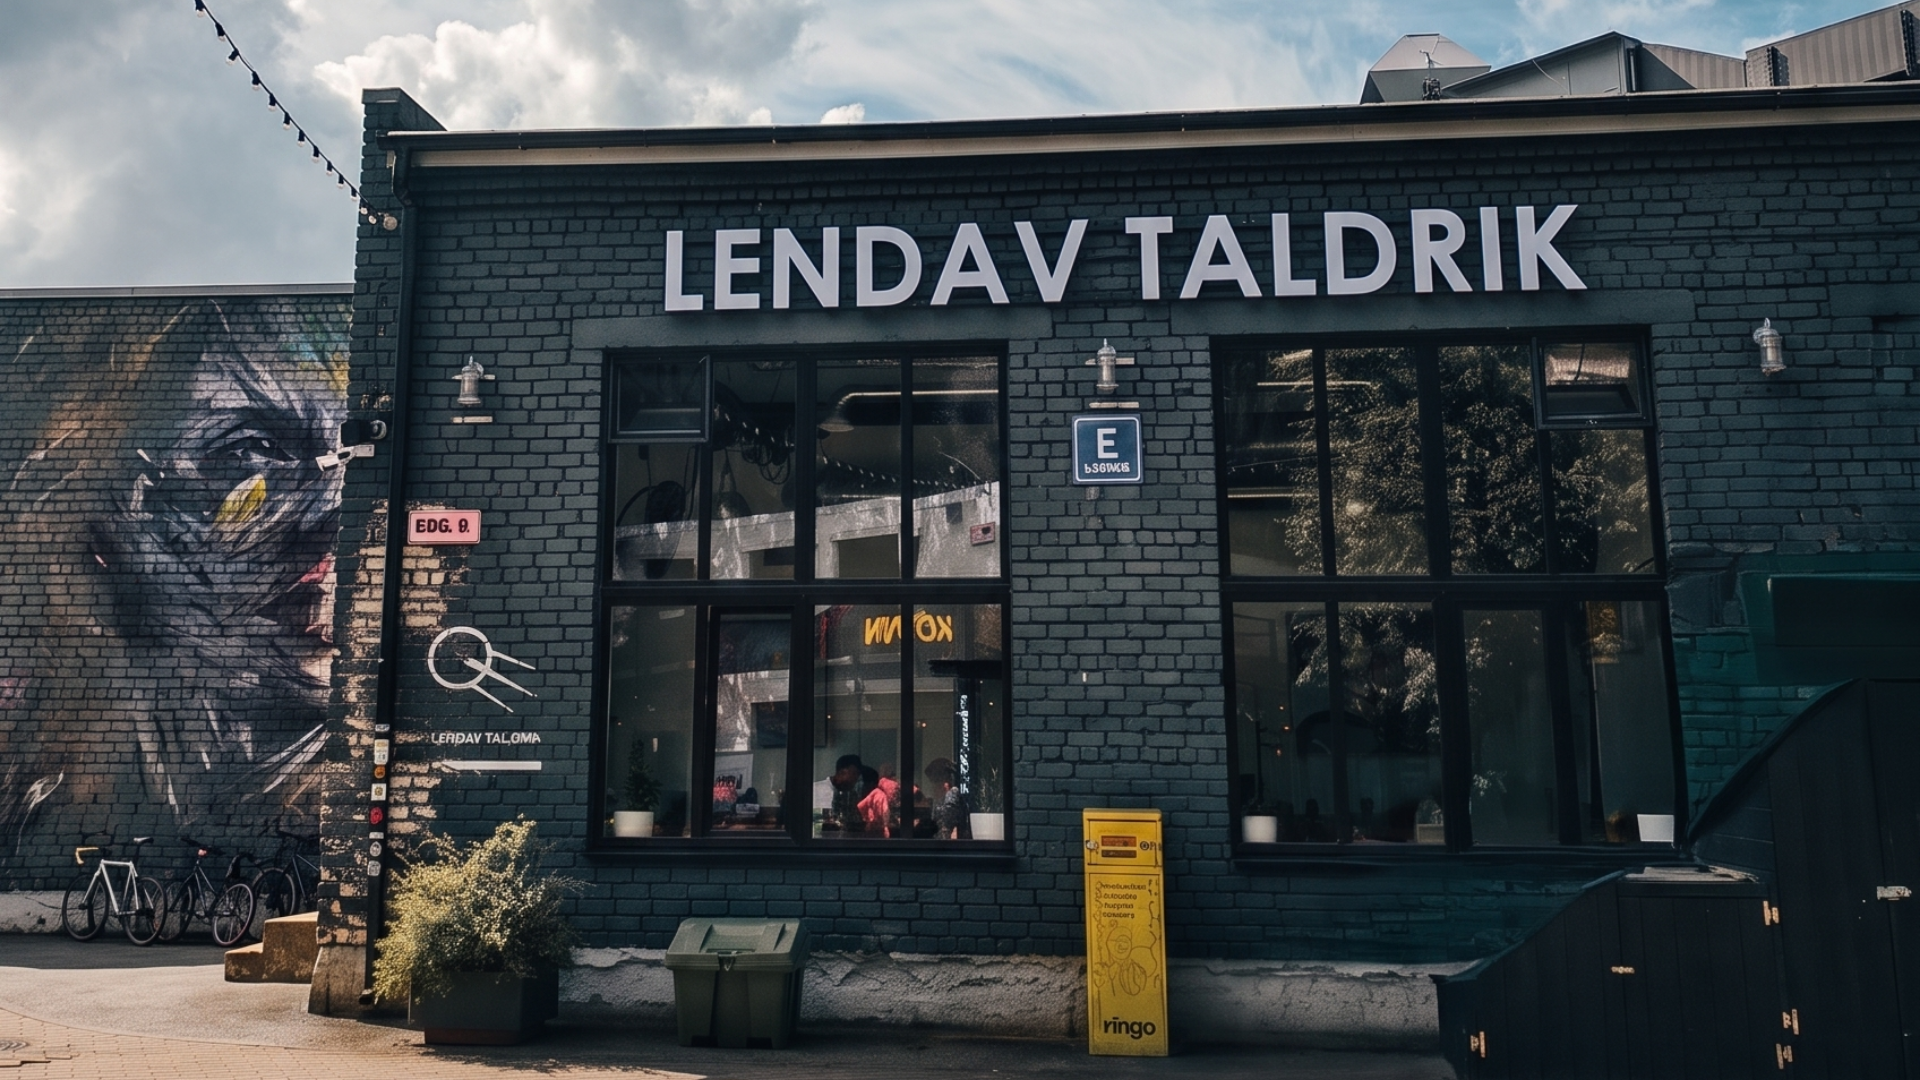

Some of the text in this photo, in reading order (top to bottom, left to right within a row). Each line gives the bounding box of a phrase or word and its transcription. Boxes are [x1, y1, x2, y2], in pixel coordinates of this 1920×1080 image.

[665, 205, 1587, 311] LENDAV TALDRIK
[1097, 428, 1118, 458] E
